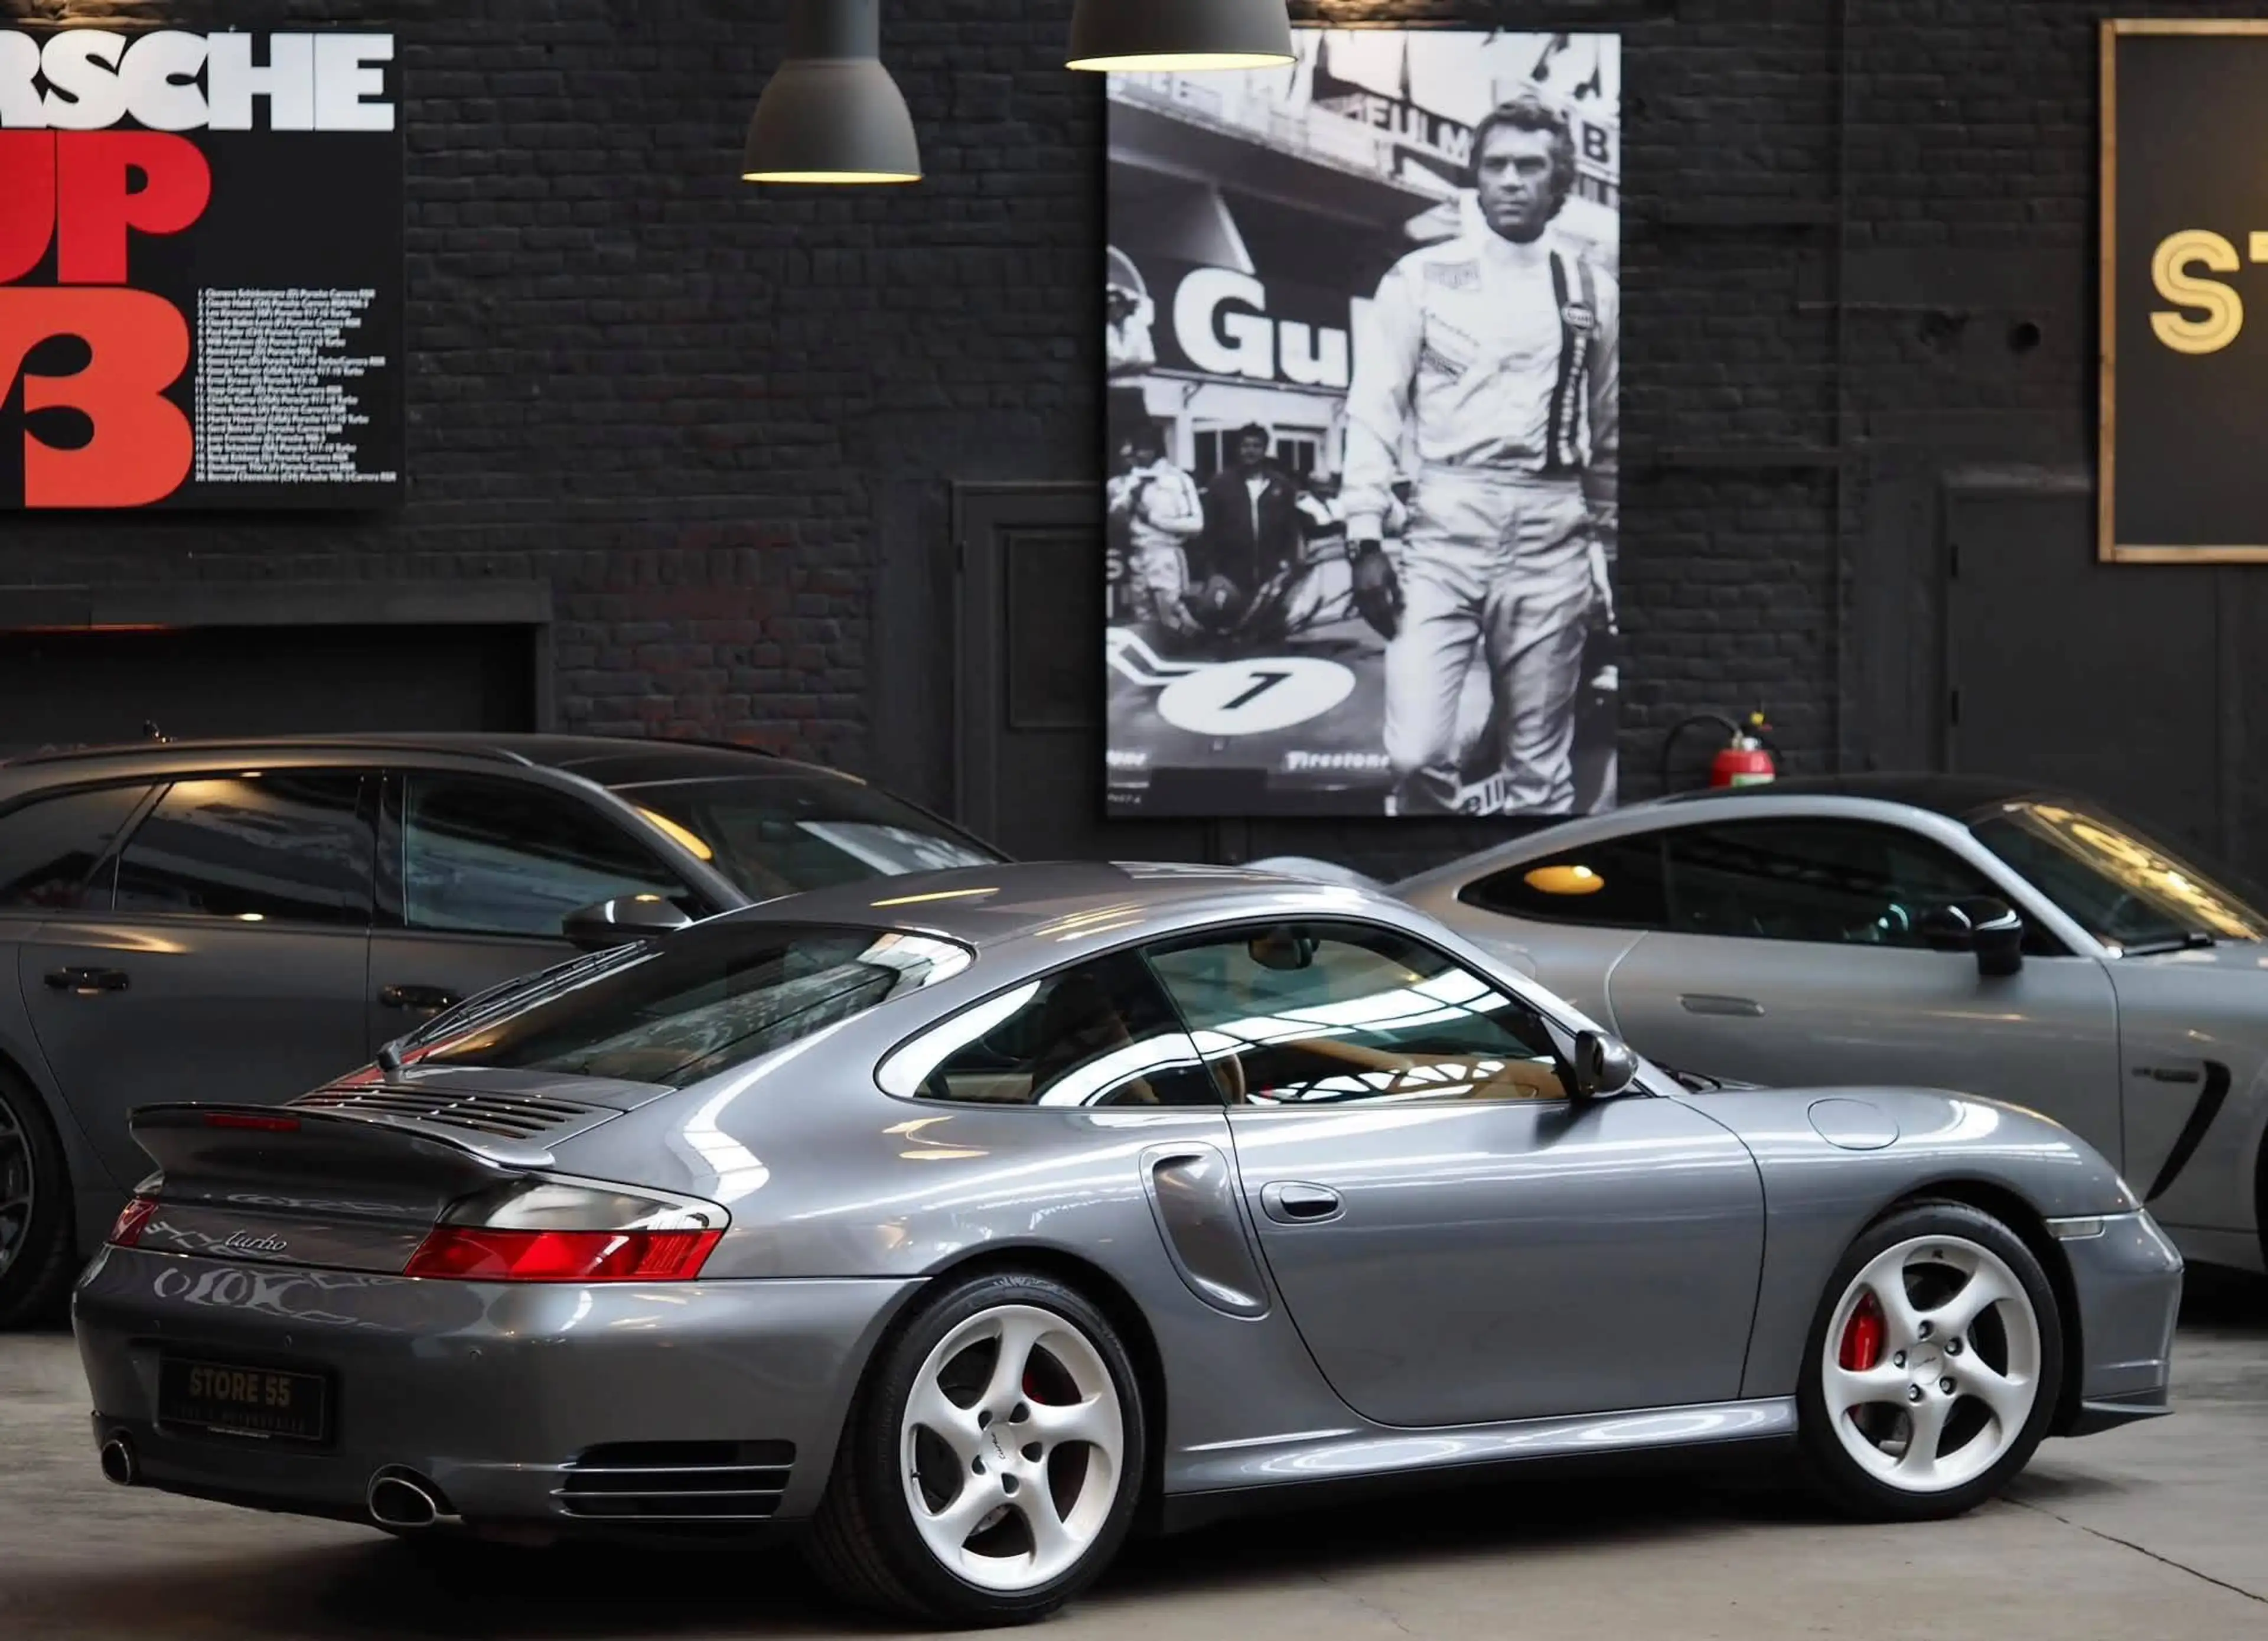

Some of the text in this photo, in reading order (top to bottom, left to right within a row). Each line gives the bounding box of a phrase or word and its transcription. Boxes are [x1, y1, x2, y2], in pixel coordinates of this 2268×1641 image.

[2149, 229, 2268, 354] S
[225, 1229, 288, 1251] turbo
[189, 1365, 292, 1408] STORE 55
